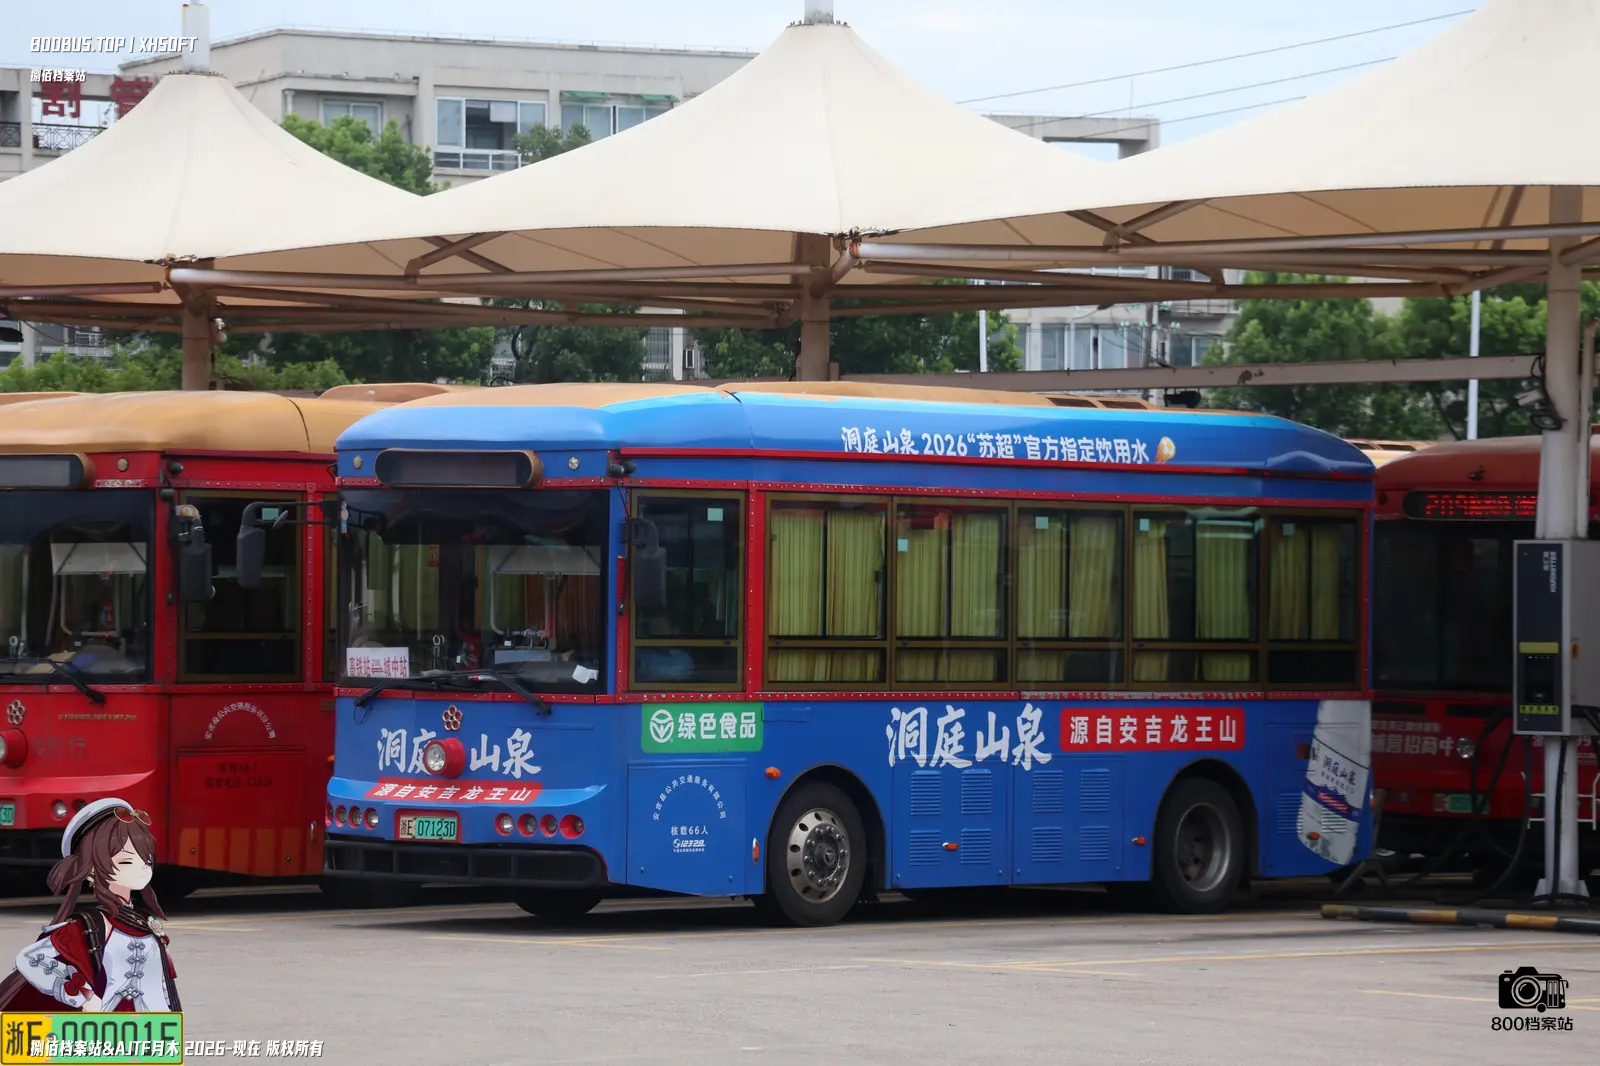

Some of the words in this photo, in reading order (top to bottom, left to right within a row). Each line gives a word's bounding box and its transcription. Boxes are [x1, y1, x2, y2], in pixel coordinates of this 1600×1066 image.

[841, 426, 919, 456] 洞庭山泉
[678, 712, 756, 740] 绿色食品
[886, 702, 1052, 770] 洞庭山泉
[1070, 714, 1236, 745] 源自安吉龙王山
[373, 782, 533, 802] 源自安吉龙王山
[671, 825, 709, 836] 核载66人
